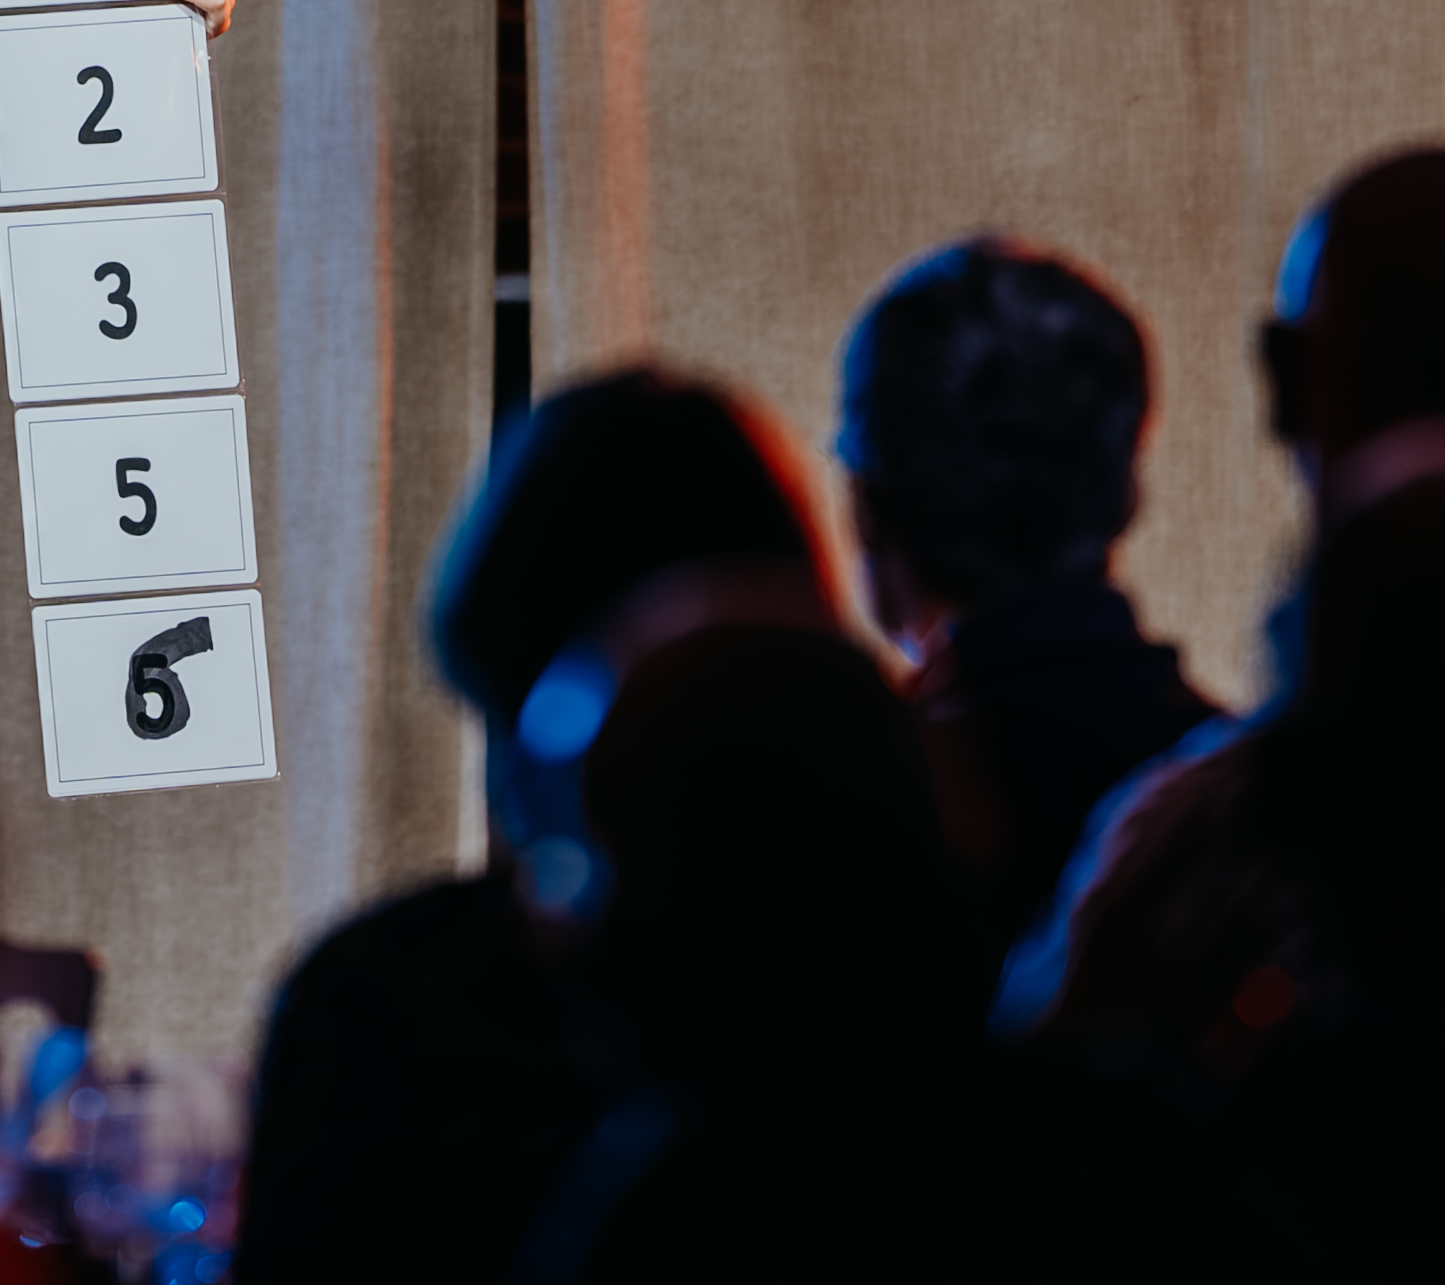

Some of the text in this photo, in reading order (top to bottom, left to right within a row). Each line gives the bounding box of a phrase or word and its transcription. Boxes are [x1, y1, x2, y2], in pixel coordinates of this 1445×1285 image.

[76, 65, 123, 145] 2
[94, 261, 138, 340] 3
[115, 457, 157, 537] 5
